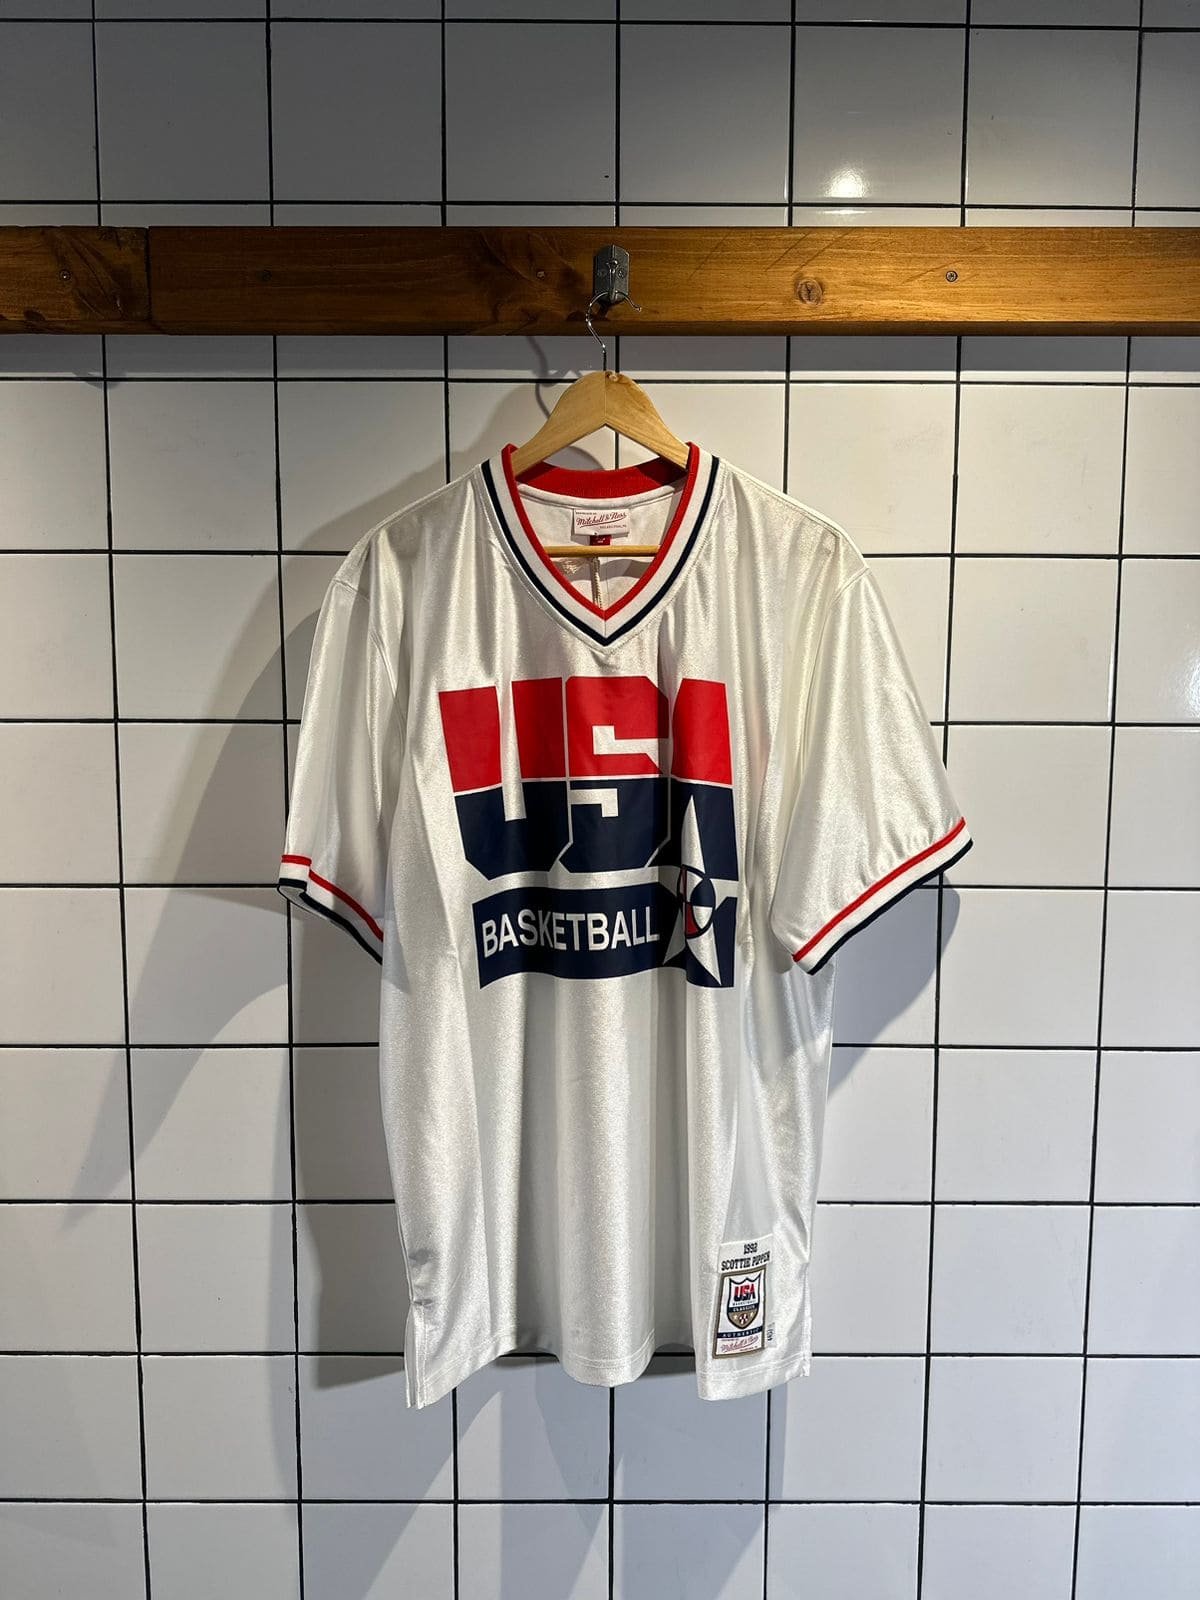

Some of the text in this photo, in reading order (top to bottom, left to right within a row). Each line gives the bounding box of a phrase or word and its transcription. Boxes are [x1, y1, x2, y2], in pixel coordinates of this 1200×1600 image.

[576, 514, 604, 526] Mitchell
[611, 512, 627, 520] Ness
[438, 676, 739, 881] USA
[481, 906, 660, 959] BASKETBALL
[743, 1242, 758, 1255] 1992
[721, 1257, 751, 1271] SCOTTIE
[734, 1284, 756, 1302] USA
